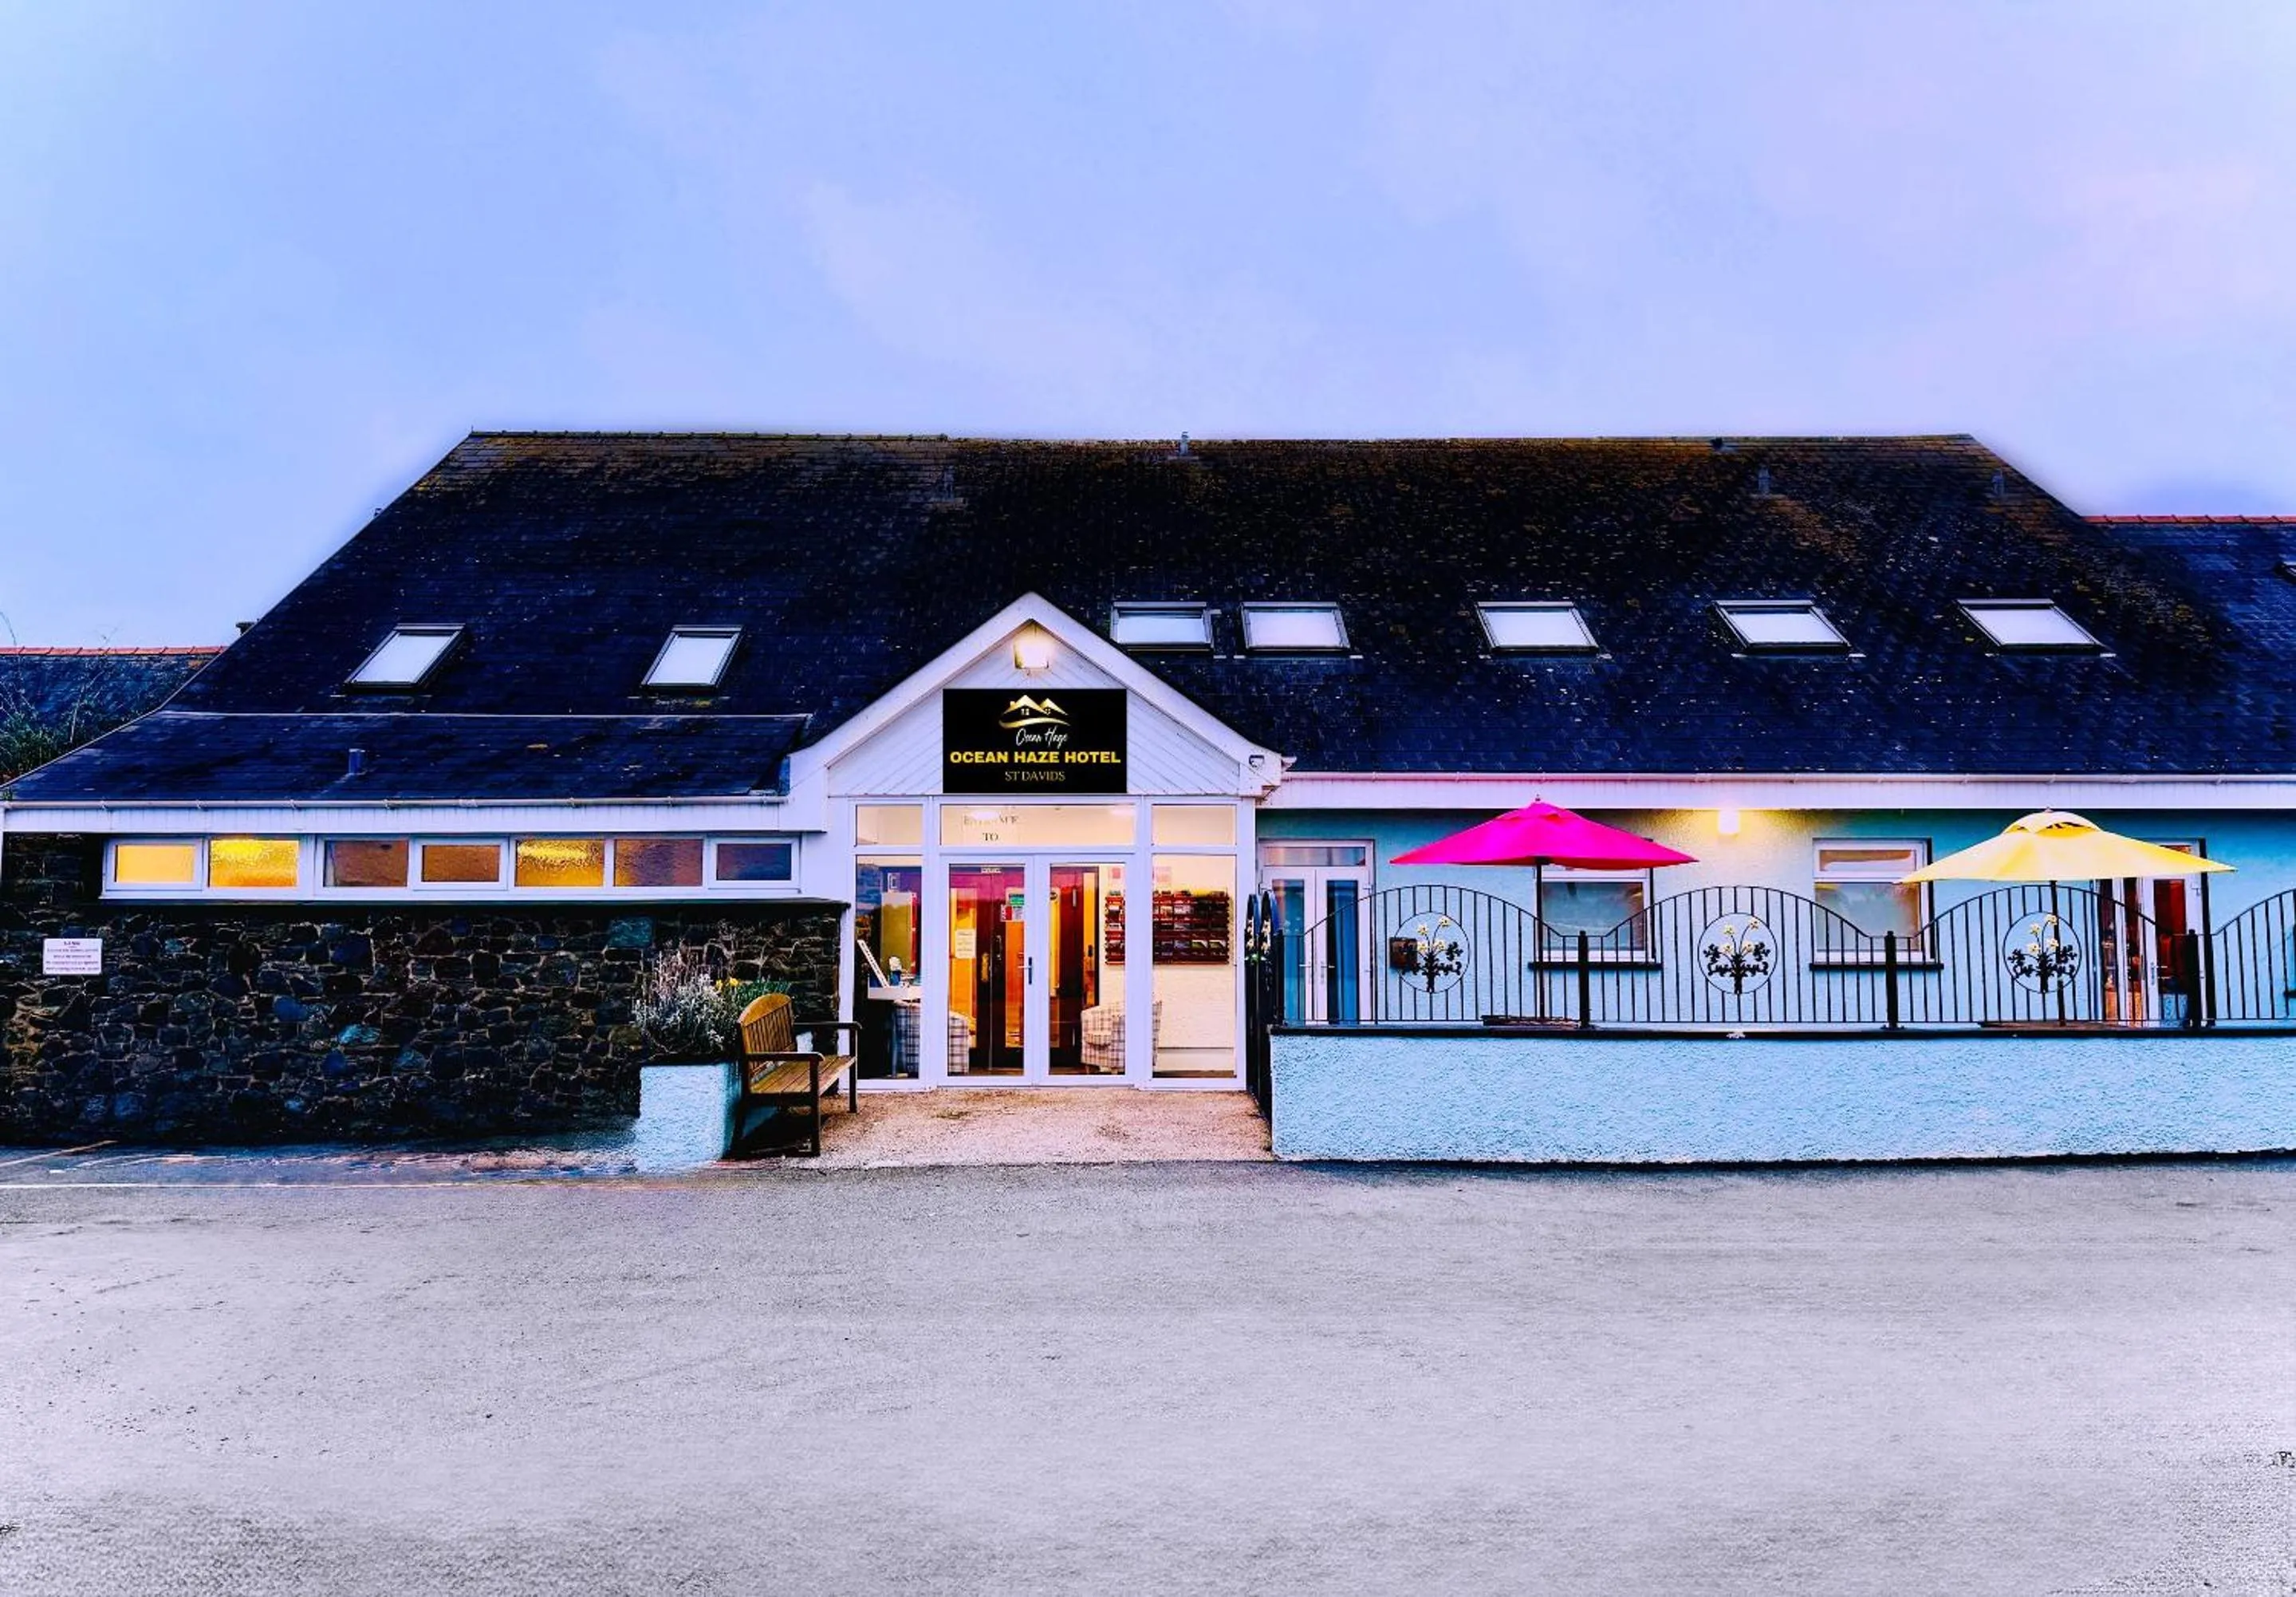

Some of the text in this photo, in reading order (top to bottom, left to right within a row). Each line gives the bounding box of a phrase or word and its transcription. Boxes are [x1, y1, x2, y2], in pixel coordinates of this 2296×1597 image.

[950, 751, 1120, 764] OCEAN HAZE HOTEL
[1005, 771, 1066, 782] ST DAVIDS
